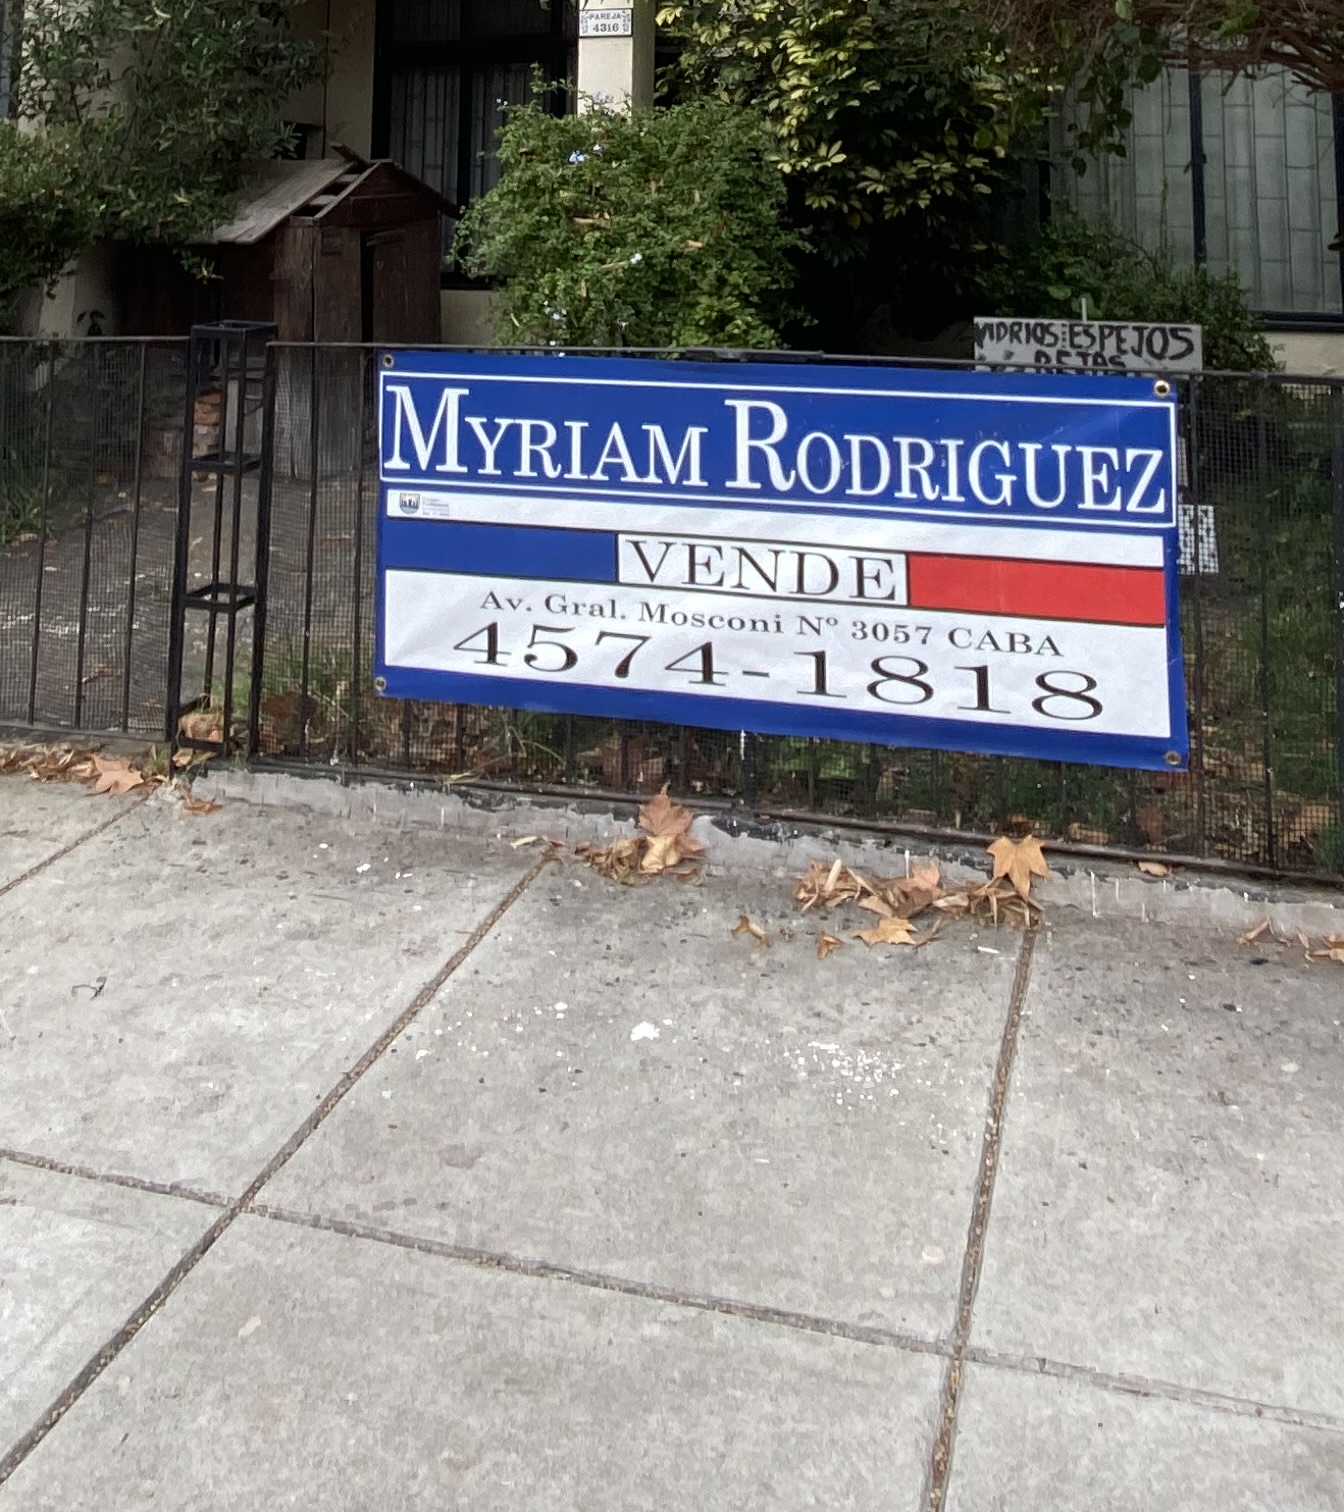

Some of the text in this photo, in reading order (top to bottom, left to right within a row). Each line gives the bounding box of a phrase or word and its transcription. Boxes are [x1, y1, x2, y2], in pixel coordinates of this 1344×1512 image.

[589, 12, 622, 20] PAREJA
[593, 23, 619, 32] 4316
[383, 385, 1166, 514] MYRIAM RODRIGUEZ
[624, 539, 897, 601] VENDE
[480, 590, 533, 612] Av.
[544, 593, 627, 620] Gral.
[638, 601, 784, 634] Mosconi
[851, 619, 933, 645] 3057
[947, 627, 1065, 658] CABA
[452, 621, 1104, 721] 4574-1818
